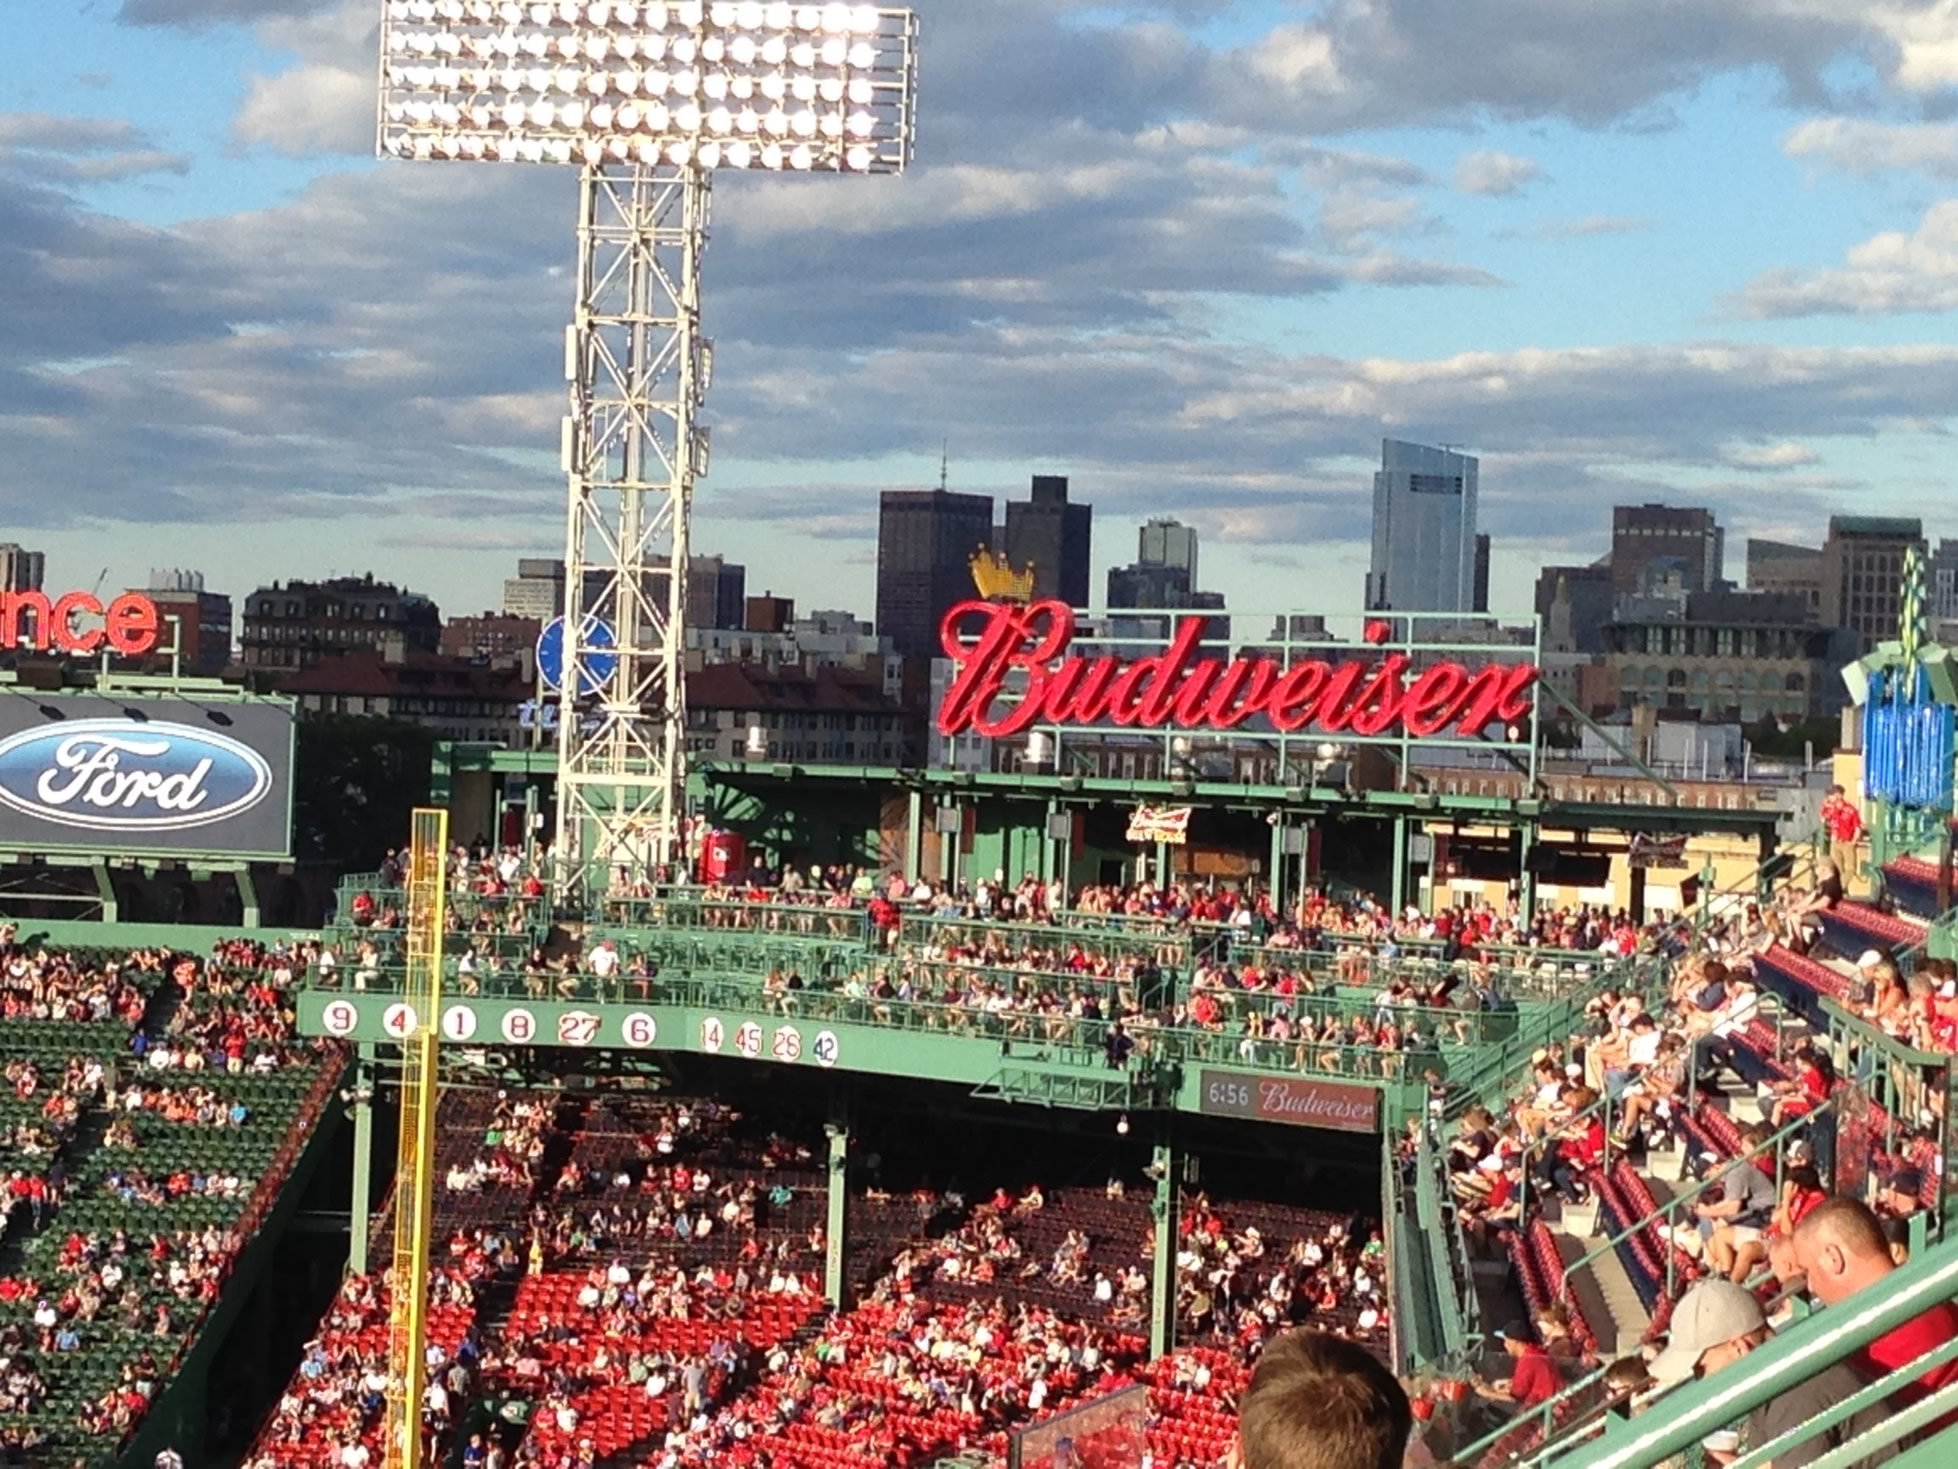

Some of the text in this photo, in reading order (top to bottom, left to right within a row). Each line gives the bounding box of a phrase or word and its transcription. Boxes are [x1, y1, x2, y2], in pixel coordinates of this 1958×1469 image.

[0, 591, 158, 653] nce
[937, 599, 1540, 737] Budweiser
[37, 734, 214, 810] Ford
[332, 1007, 351, 1030] 9
[509, 1014, 529, 1039] 8
[559, 1016, 602, 1042] 27
[630, 1018, 650, 1044] 6
[702, 1024, 835, 1061] 14 45 26 42
[1209, 1081, 1374, 1119] 6:56 Budweiser
